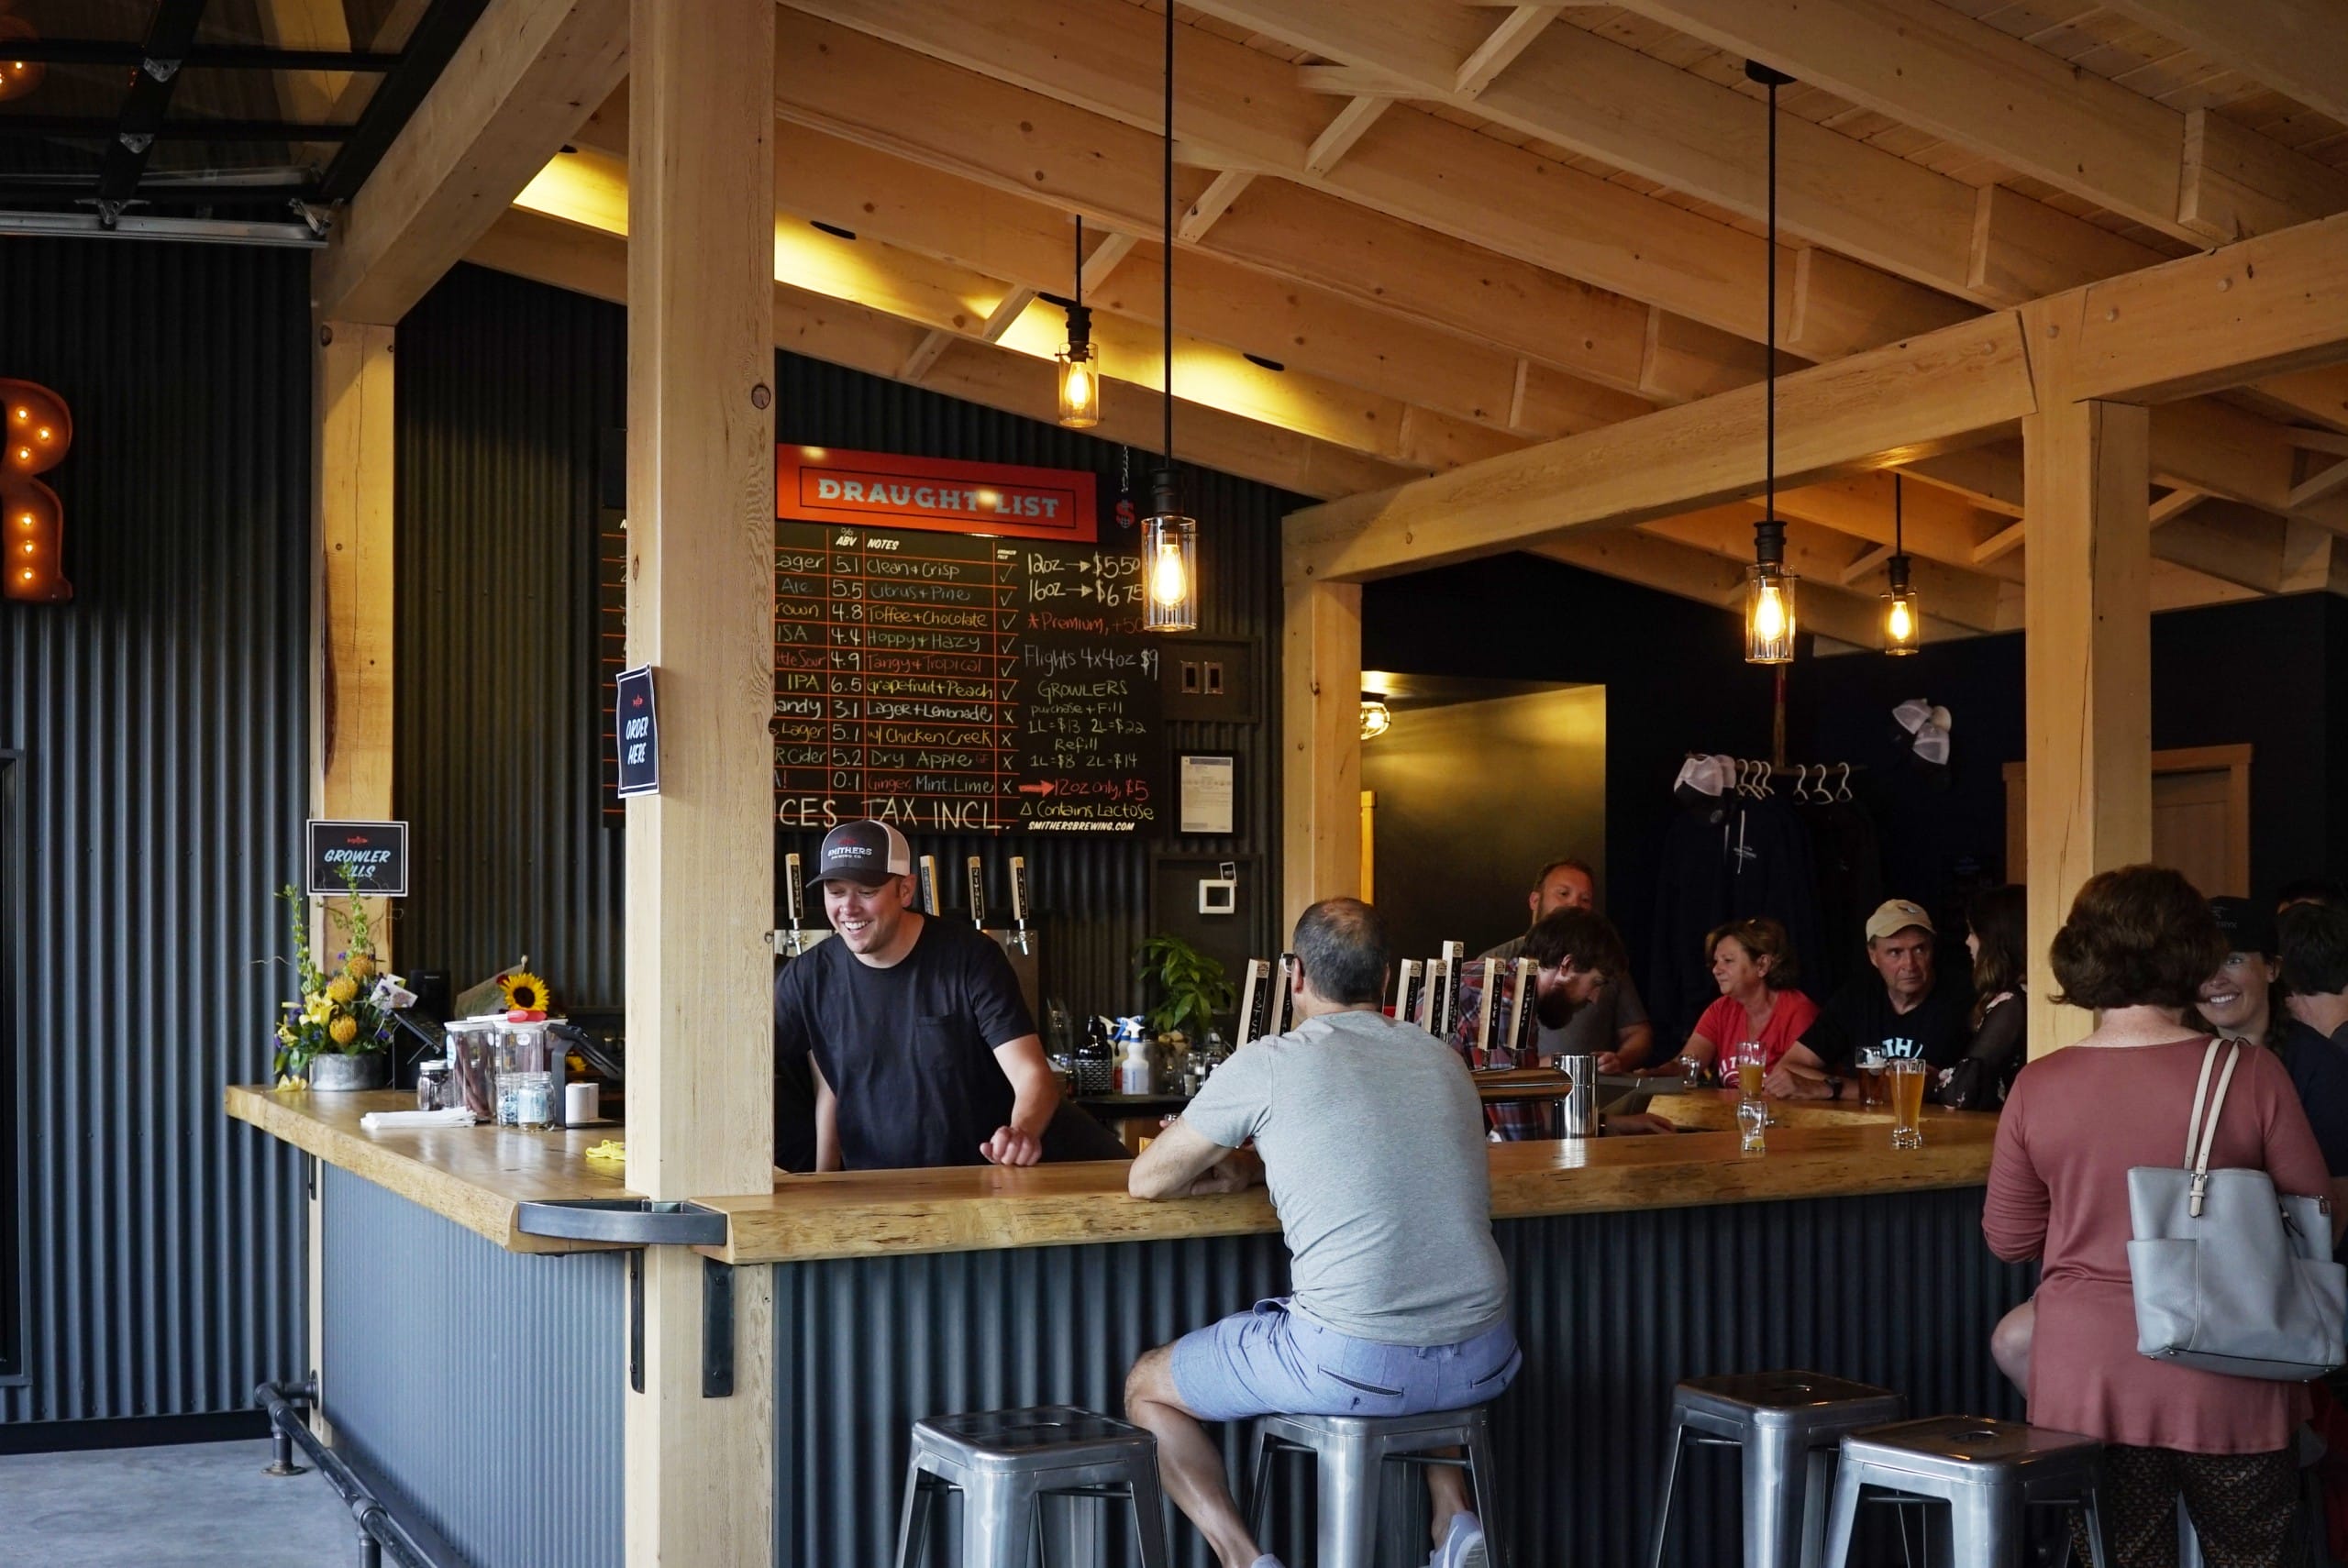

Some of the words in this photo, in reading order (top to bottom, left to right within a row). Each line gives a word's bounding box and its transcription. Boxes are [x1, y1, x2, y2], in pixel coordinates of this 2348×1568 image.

[818, 478, 979, 512] DRAUGHT
[994, 494, 1060, 518] LIST
[836, 536, 858, 547] ABV
[866, 538, 900, 550] NOTES
[834, 556, 858, 573] 5.1
[867, 558, 909, 576] Clean
[922, 562, 960, 580] Crisp
[1027, 552, 1066, 576] 12oz
[1092, 550, 1141, 579] $5.50
[832, 579, 863, 600] 5.5
[870, 582, 916, 600] Citrus
[931, 586, 970, 601] Pine
[1028, 579, 1067, 602] 16oz
[832, 602, 863, 622] 4.8
[867, 605, 913, 623] Toffee
[923, 610, 988, 627] Chocolate
[831, 627, 861, 646] 4.4
[867, 630, 915, 650] Hoppy
[932, 633, 980, 652] Hazy
[831, 651, 860, 671] 4.9
[867, 653, 911, 673] Tangy
[924, 654, 981, 674] Tropical
[1024, 644, 1078, 678] Flights
[1140, 647, 1159, 681] $9
[788, 674, 819, 691] IPA
[831, 677, 862, 693] 6.5
[946, 679, 992, 700] Peach
[1037, 679, 1129, 704] GROWLERS
[833, 700, 858, 719] 3.1
[924, 703, 993, 723] Lemonade
[1097, 701, 1123, 714] Fill
[626, 716, 649, 741] ORDER
[781, 722, 826, 743] Lager
[832, 723, 859, 741] 5.1
[886, 727, 945, 745] Chicken
[946, 729, 993, 747] Creek
[627, 742, 647, 766] HERE
[787, 745, 827, 764] Cider
[1055, 737, 1098, 753] Refill
[832, 749, 863, 767] 5.2
[870, 749, 904, 768] Dry
[916, 750, 972, 769] Apple
[833, 771, 859, 790] 0.1
[954, 777, 994, 793] Lime
[1055, 779, 1091, 796] 12oz
[1126, 778, 1149, 801] $5
[860, 795, 918, 826] TAX
[934, 801, 1011, 831] INCL.
[1037, 800, 1093, 818] Contains
[1097, 802, 1155, 820] Lactose
[1027, 821, 1135, 831] SMITHERSBREWING.COM
[324, 849, 392, 863] GROWLER
